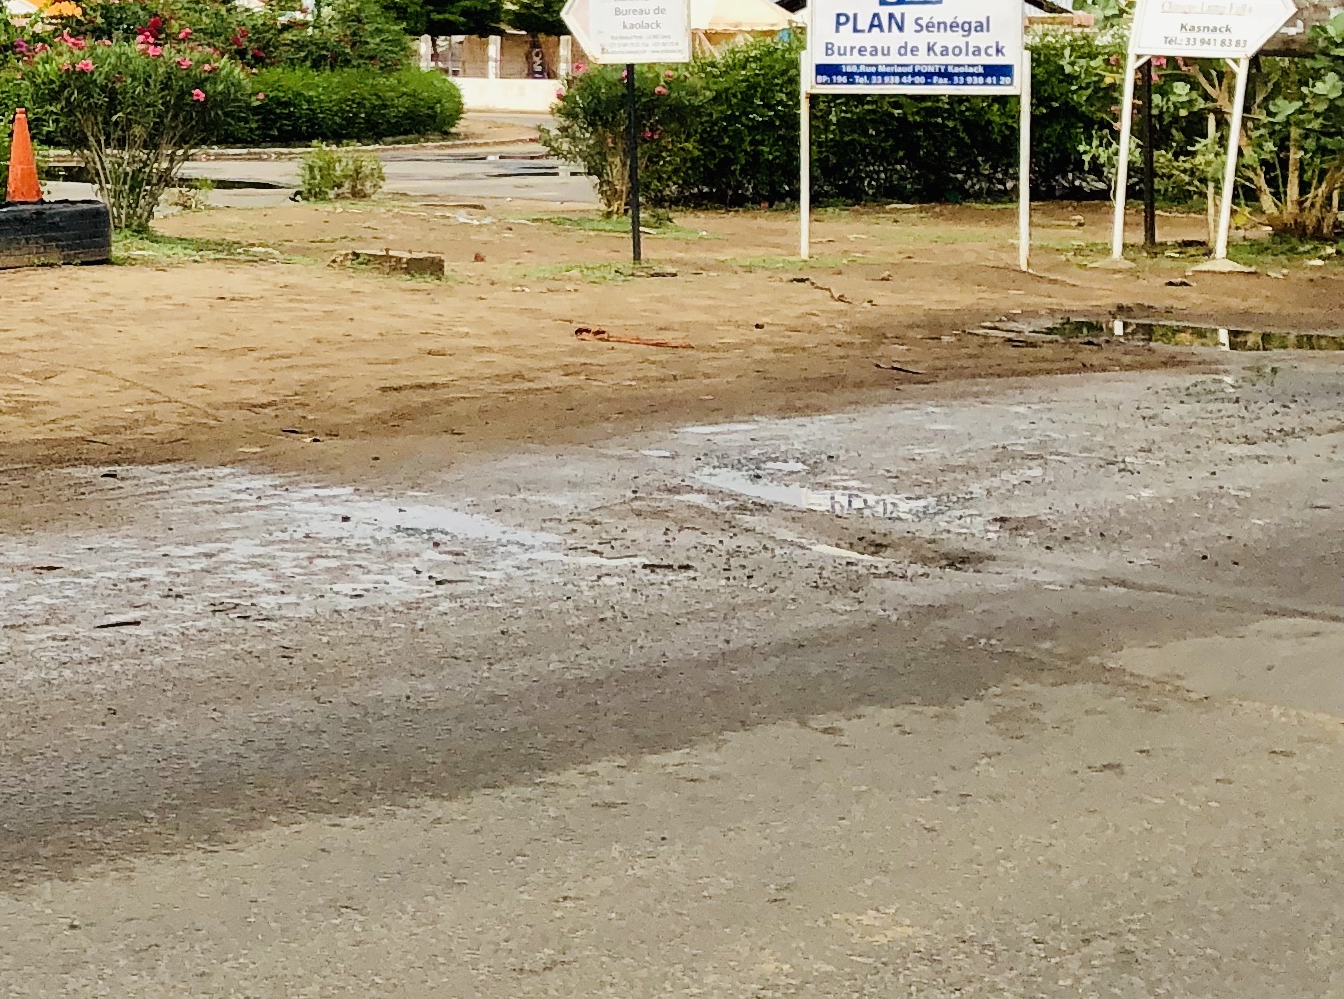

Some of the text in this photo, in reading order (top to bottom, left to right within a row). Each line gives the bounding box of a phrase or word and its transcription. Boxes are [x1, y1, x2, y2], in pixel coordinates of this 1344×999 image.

[614, 5, 666, 16] Bureau de
[622, 20, 662, 30] kaolack
[834, 12, 990, 37] PLAN Sénégal
[1180, 22, 1232, 33] Kasnack
[1185, 37, 1196, 46] 33
[1199, 37, 1217, 46] 941
[1220, 38, 1232, 47] 83
[1235, 39, 1247, 48] 83
[825, 40, 1006, 57] Bureau de Kaolack
[914, 64, 946, 73] PONTY
[947, 64, 984, 73] Kaolack
